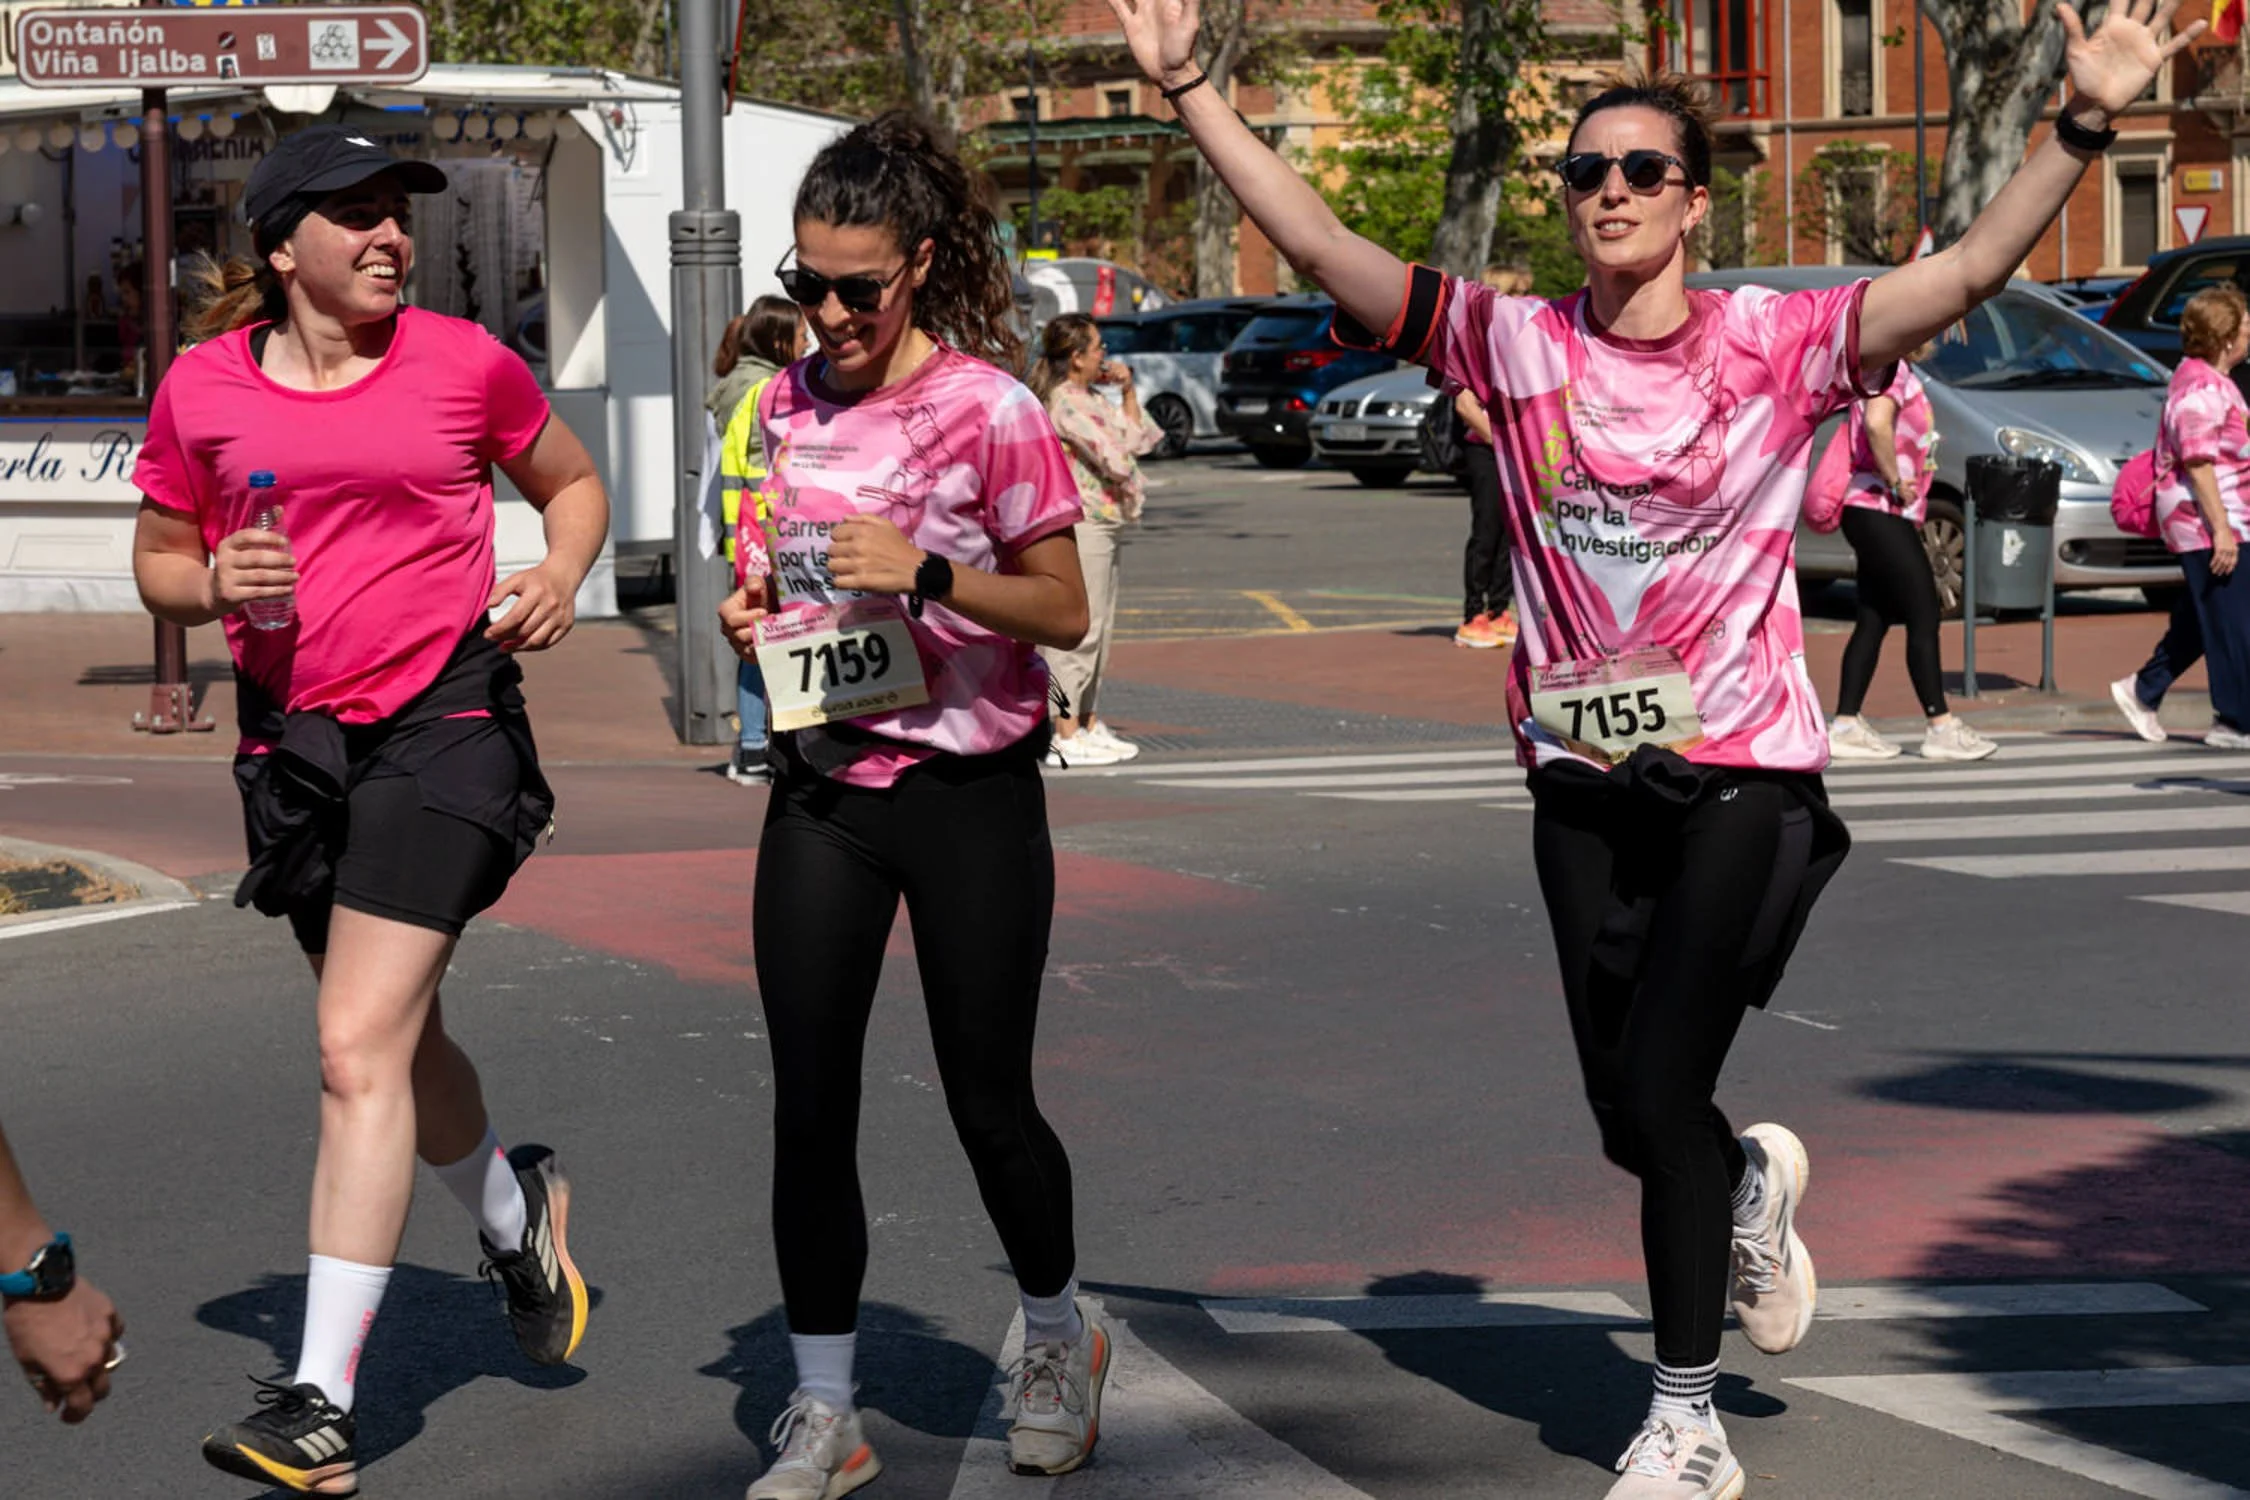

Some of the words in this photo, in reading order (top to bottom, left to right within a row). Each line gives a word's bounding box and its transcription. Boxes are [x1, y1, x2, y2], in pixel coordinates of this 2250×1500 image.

[30, 19, 164, 45] Ontañón
[31, 50, 98, 75] Viña
[119, 49, 206, 78] Ijalba
[776, 516, 840, 537] Carrer
[1558, 502, 1597, 523] por
[1603, 503, 1625, 526] la
[779, 551, 806, 573] por
[811, 545, 830, 568] la
[788, 632, 891, 693] 7159
[1560, 688, 1666, 741] 7155
